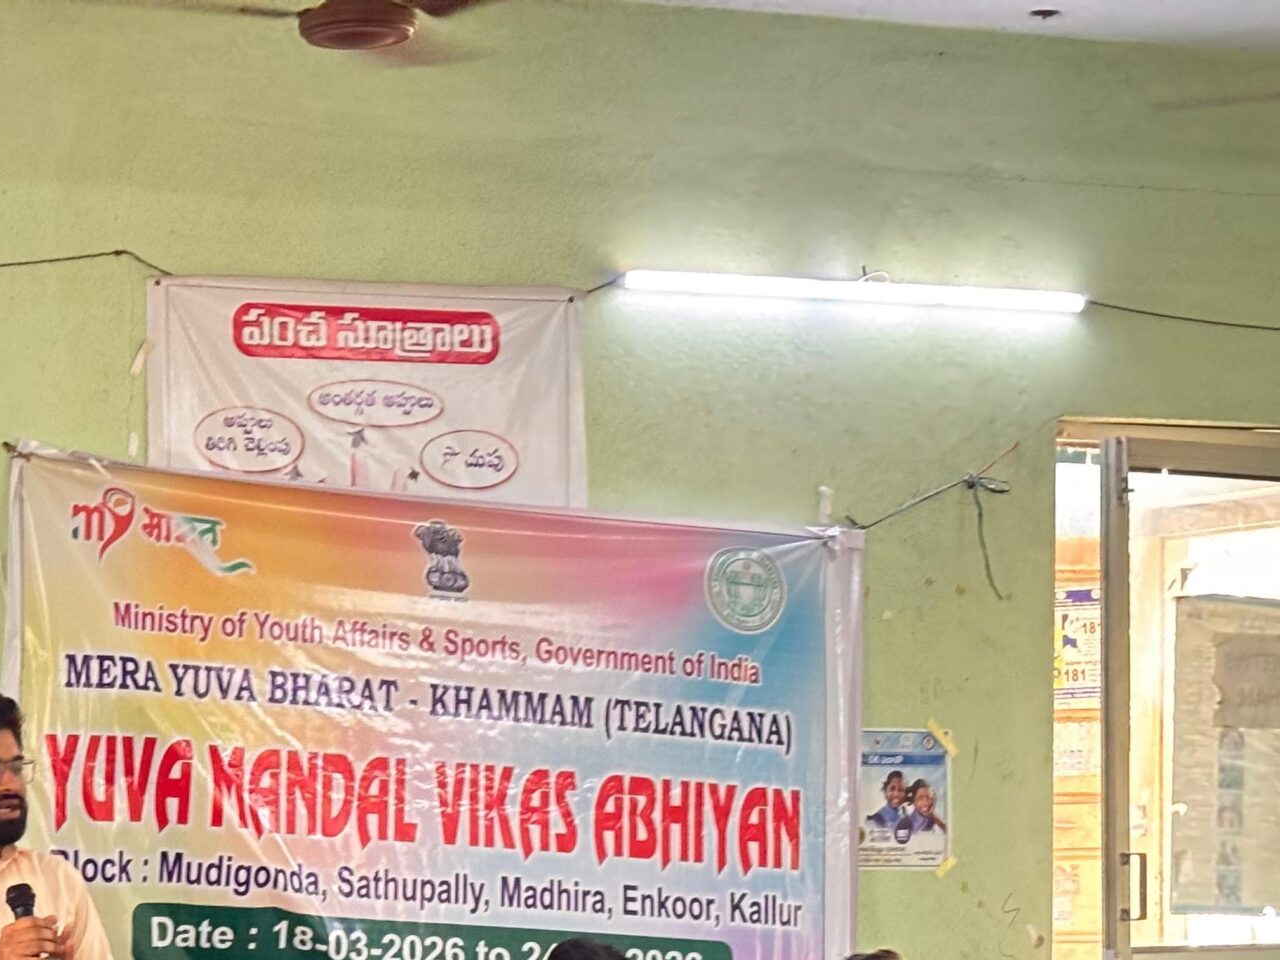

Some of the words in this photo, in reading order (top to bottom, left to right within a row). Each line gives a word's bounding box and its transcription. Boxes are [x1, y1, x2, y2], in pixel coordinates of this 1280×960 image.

[241, 308, 327, 347] పంచ
[336, 312, 492, 358] సూత్రాలు
[114, 601, 213, 642] Ministry
[222, 615, 246, 638] of
[254, 614, 323, 646] Youth
[332, 619, 411, 652] Affairs
[420, 626, 436, 653] &
[444, 629, 528, 668] Sports,
[535, 637, 676, 676] Government
[683, 652, 706, 679] of
[710, 654, 761, 684] India
[1064, 668, 1086, 682] 181
[65, 654, 162, 693] MERA
[169, 663, 258, 702] YUVA
[268, 670, 400, 714] BHARAT
[429, 683, 594, 729] KHAMMAM
[605, 697, 793, 756] (TELANGANA)
[45, 733, 194, 834] YUVA
[208, 744, 419, 850] MANDAL
[434, 760, 580, 861] VIKAS
[593, 773, 803, 878] ABHIYAN
[141, 857, 151, 884] :
[158, 850, 328, 903] Mudigonda,
[337, 864, 491, 913] Sathupally,
[500, 875, 612, 920] Madhira,
[622, 884, 722, 929] Enkoor,
[729, 891, 804, 928] Kallur
[150, 916, 235, 950] Date
[248, 925, 259, 950] :
